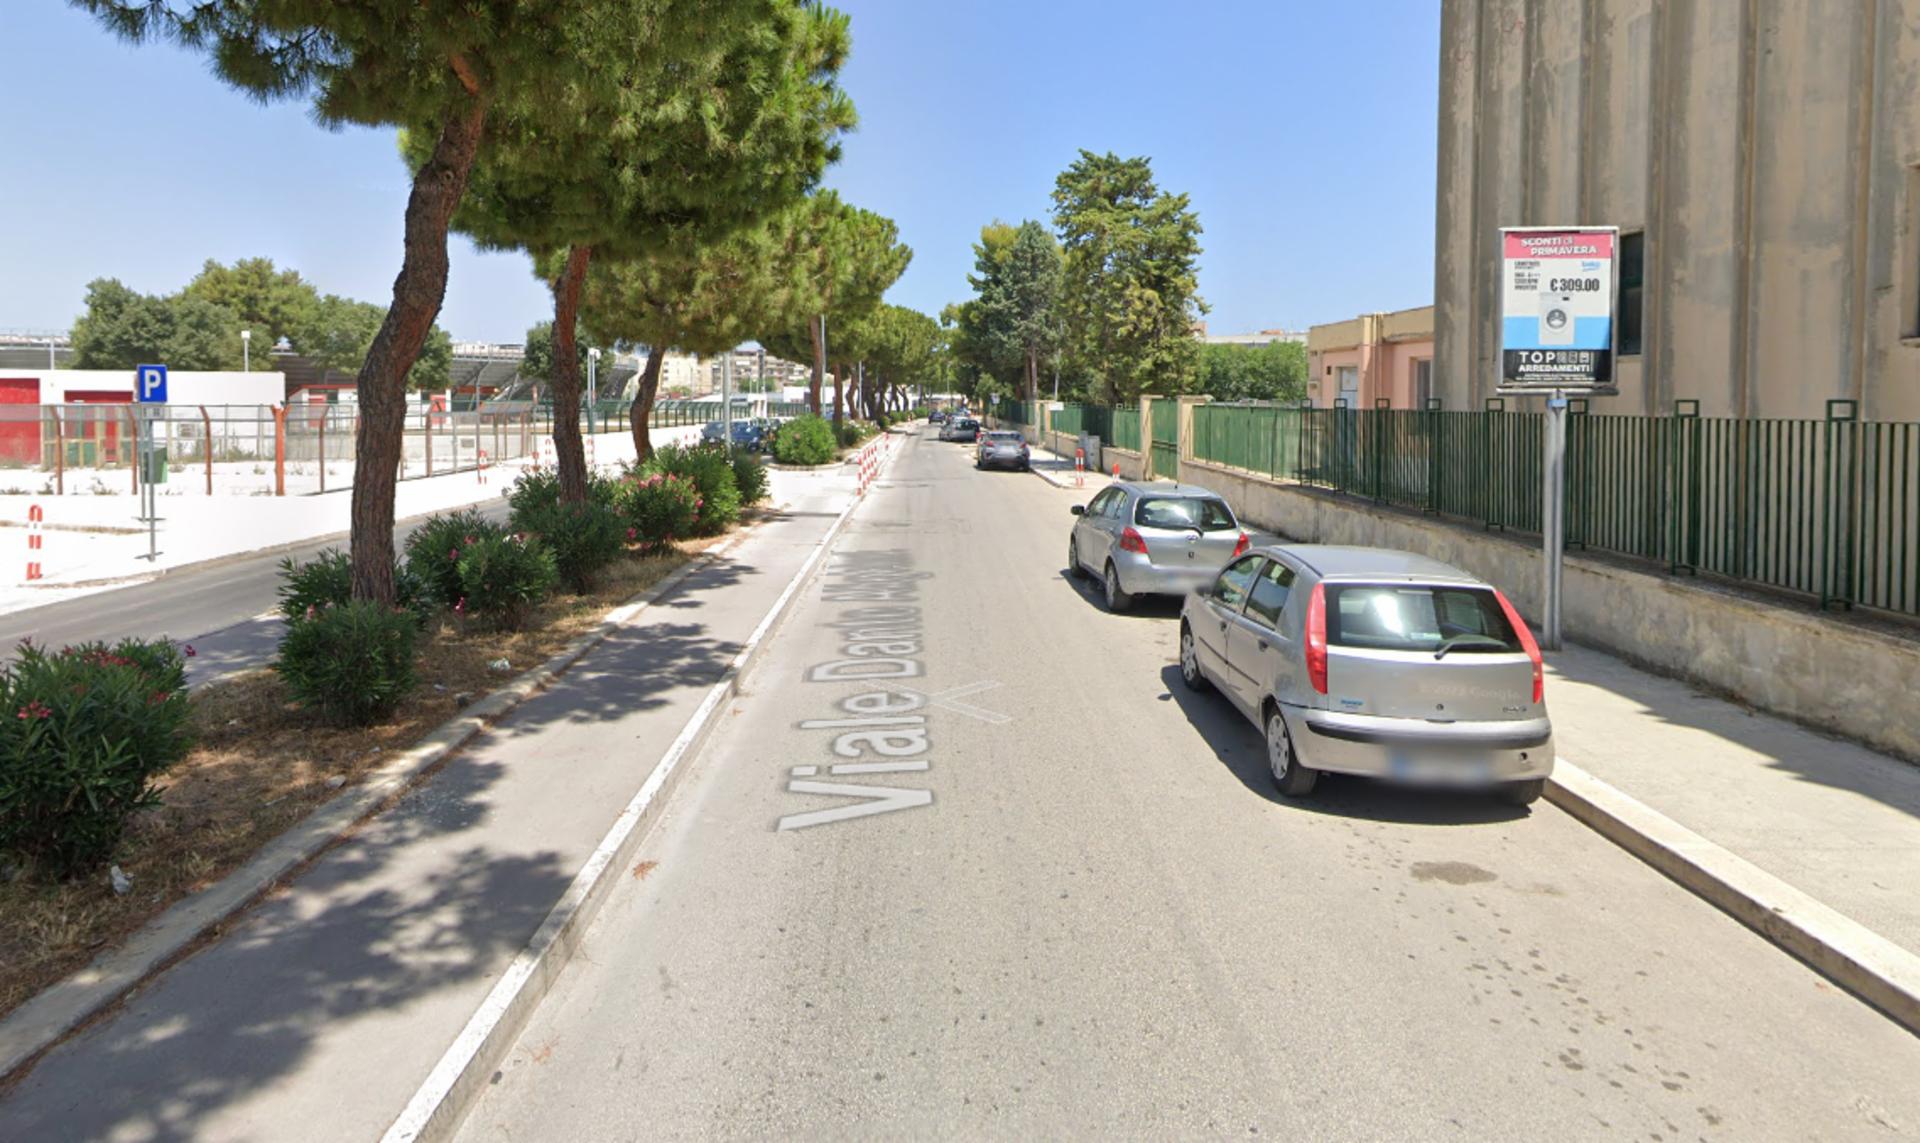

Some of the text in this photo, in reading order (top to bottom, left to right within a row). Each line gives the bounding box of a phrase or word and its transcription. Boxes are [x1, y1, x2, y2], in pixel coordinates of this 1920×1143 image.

[1521, 237, 1561, 247] SCONTI
[1530, 245, 1597, 256] PRIMAVERA
[1518, 351, 1556, 364] TOP
[1518, 364, 1590, 373] ARREDAMENTI
[144, 369, 161, 399] P
